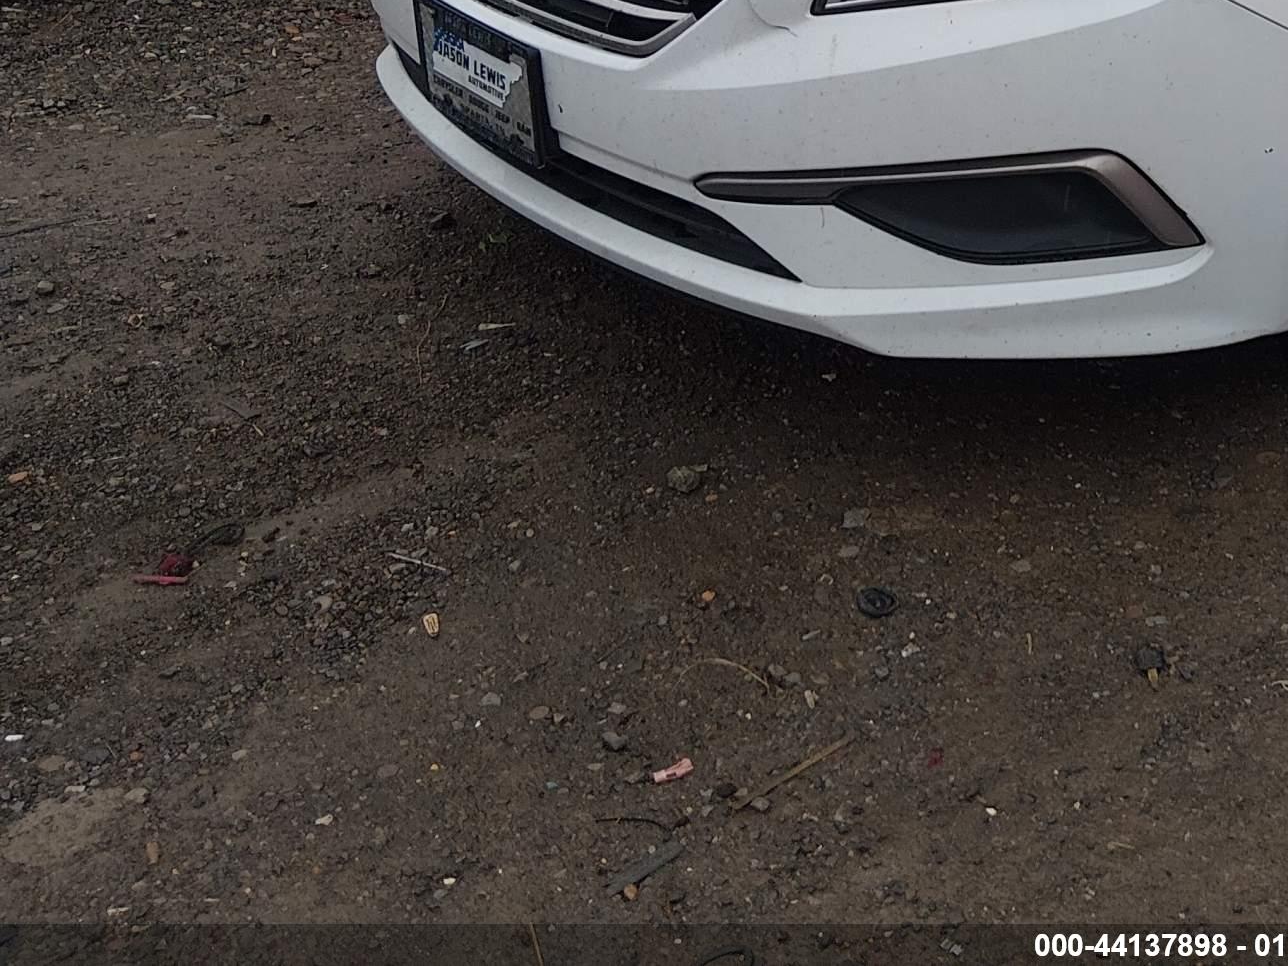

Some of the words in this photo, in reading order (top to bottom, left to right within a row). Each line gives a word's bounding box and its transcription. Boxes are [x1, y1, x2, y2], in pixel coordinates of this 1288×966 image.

[437, 41, 470, 70] JASON
[474, 60, 506, 91] LEWIS
[468, 74, 504, 101] AUTOMOTIVE
